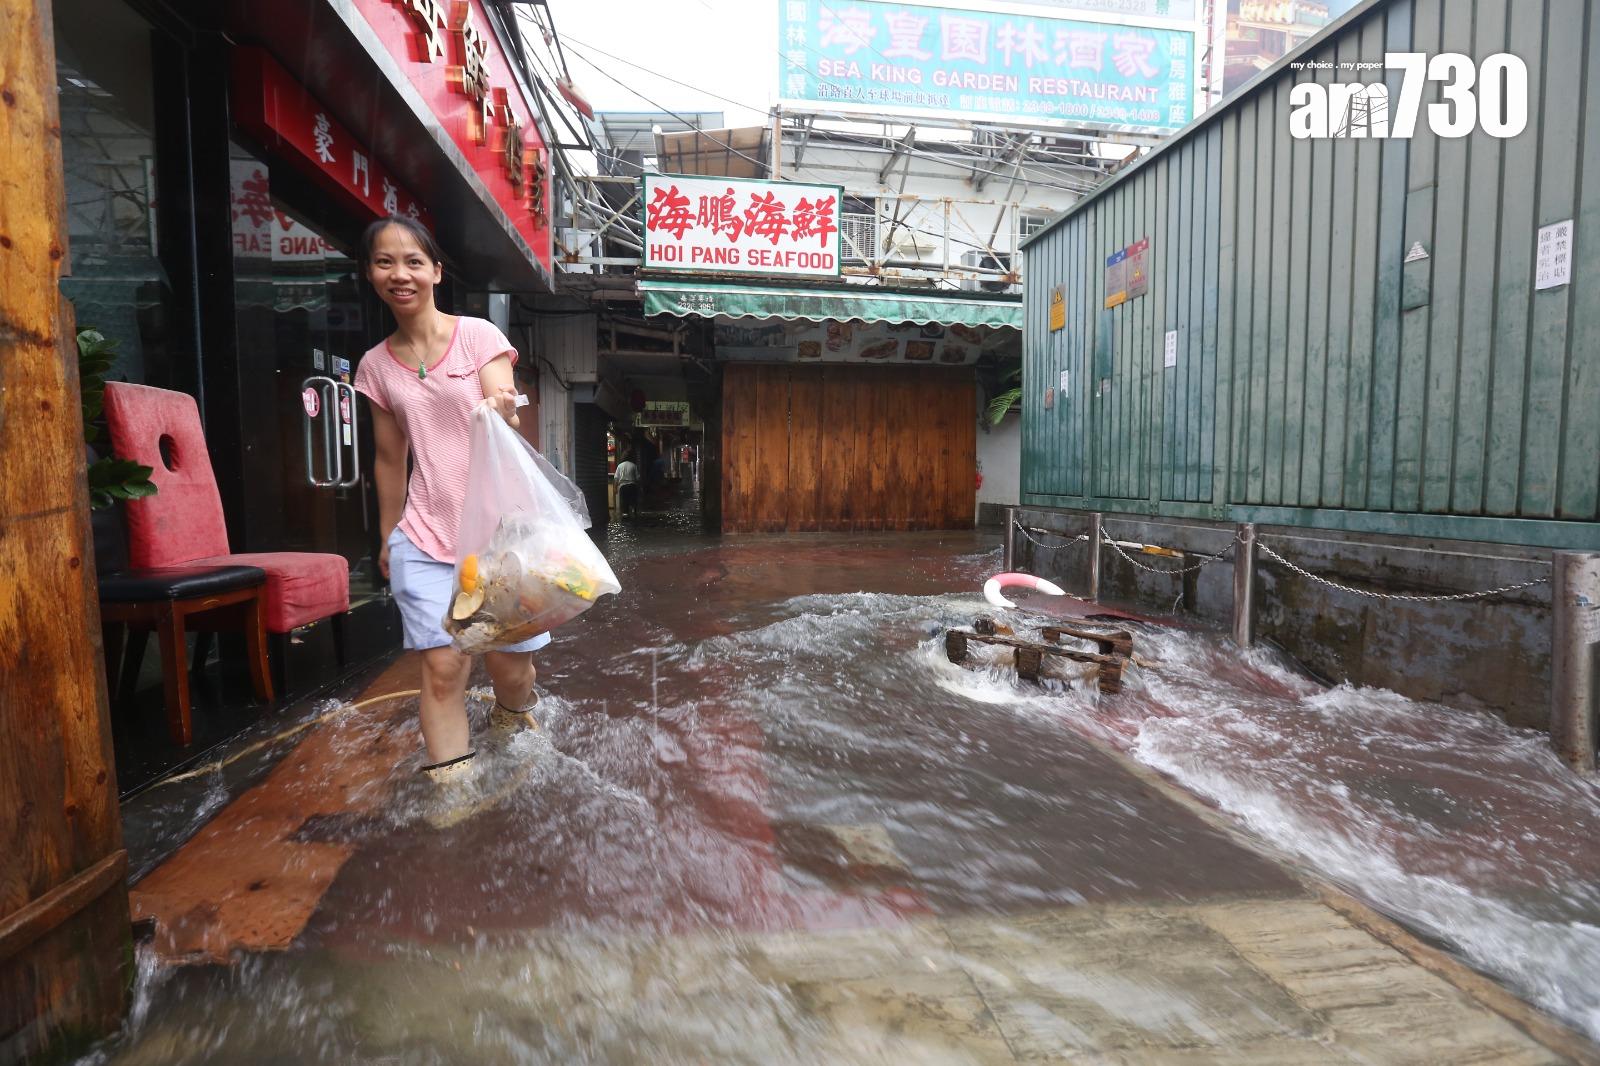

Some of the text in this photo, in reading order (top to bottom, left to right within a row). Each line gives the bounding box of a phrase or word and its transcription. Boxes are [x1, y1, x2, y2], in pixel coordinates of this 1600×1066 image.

[817, 6, 1159, 78] 海皇園林酒家
[819, 60, 1159, 103] SEA KING GARDEN RESTAURANT
[646, 185, 838, 248] 海鵬海鮮
[650, 244, 834, 269] HOI PANG SEAFOOD
